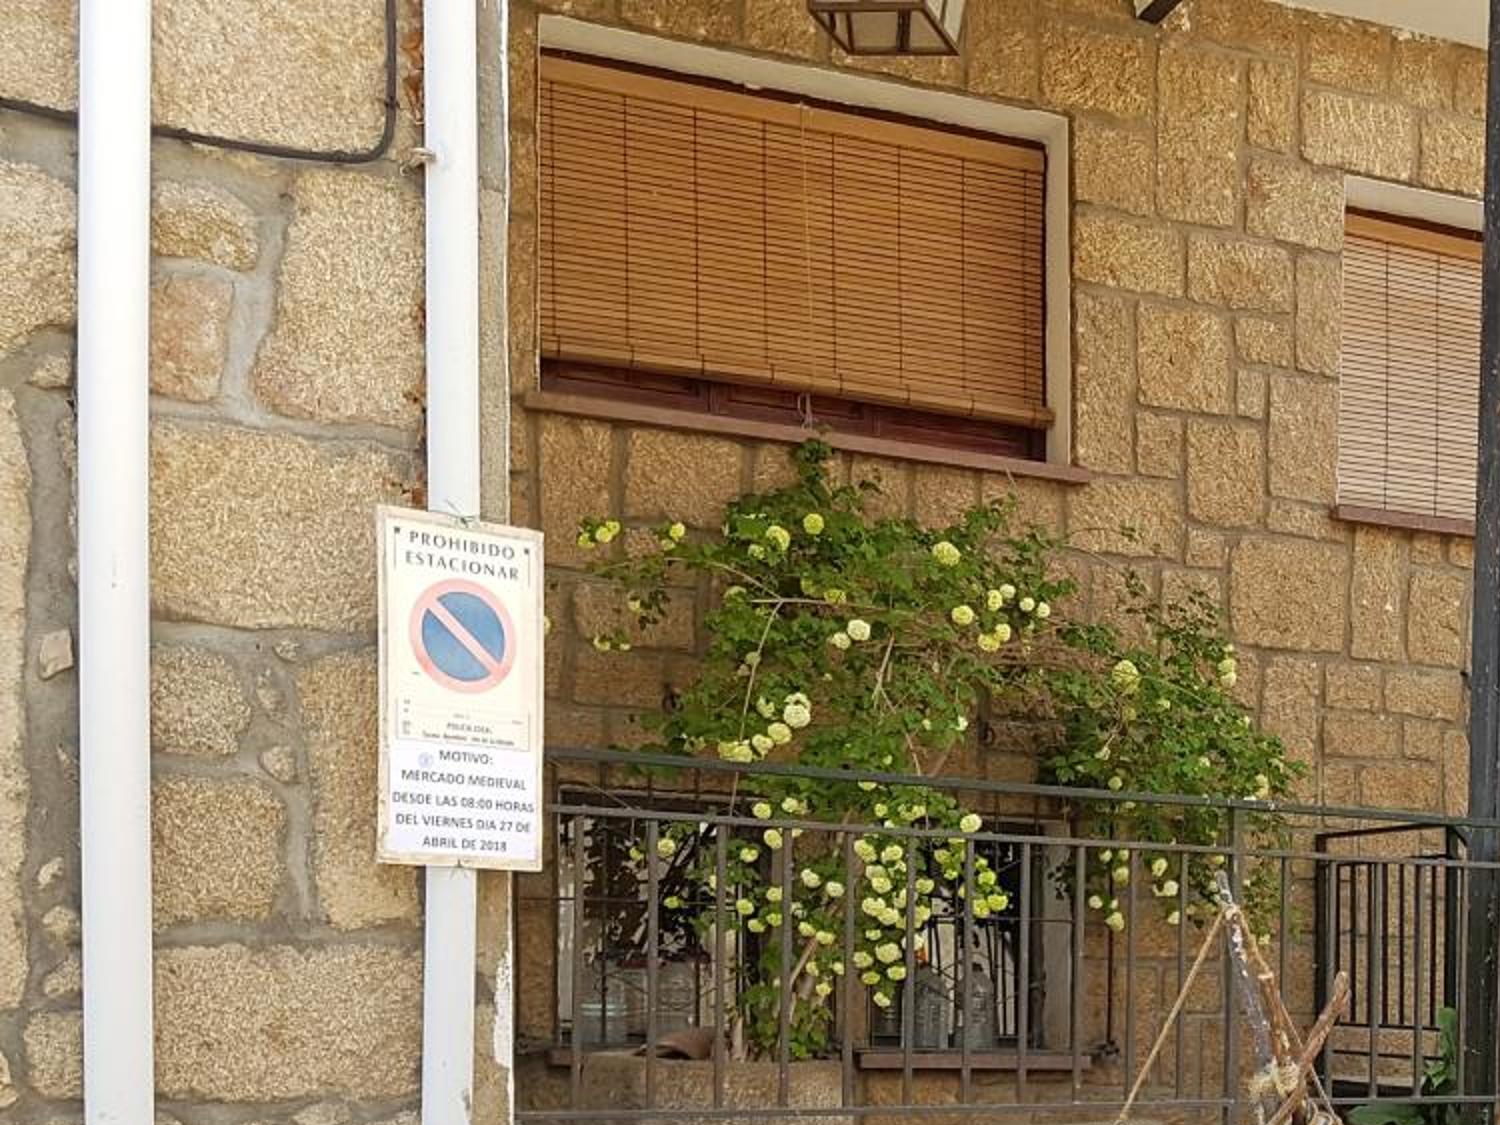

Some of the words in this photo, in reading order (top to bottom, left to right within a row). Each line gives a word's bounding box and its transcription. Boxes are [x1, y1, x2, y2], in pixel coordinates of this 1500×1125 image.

[409, 530, 515, 560] PROHIBIDO
[405, 551, 519, 580] ESTACIONAR
[439, 750, 494, 765] MOTIVO:
[401, 769, 465, 785] MERCADO
[468, 775, 527, 791] MEDIEVAL
[392, 791, 432, 805] DESDE
[435, 795, 457, 807] LAS
[460, 797, 493, 810] 08:00
[495, 800, 534, 813] HORAS
[395, 813, 419, 826] DEL
[422, 815, 473, 829] VIERNES
[476, 819, 497, 831] DIA
[500, 821, 513, 832] 27
[515, 822, 530, 834] DE
[422, 835, 458, 849] ABRIL
[461, 838, 476, 850] DE
[480, 839, 507, 852] 2018
